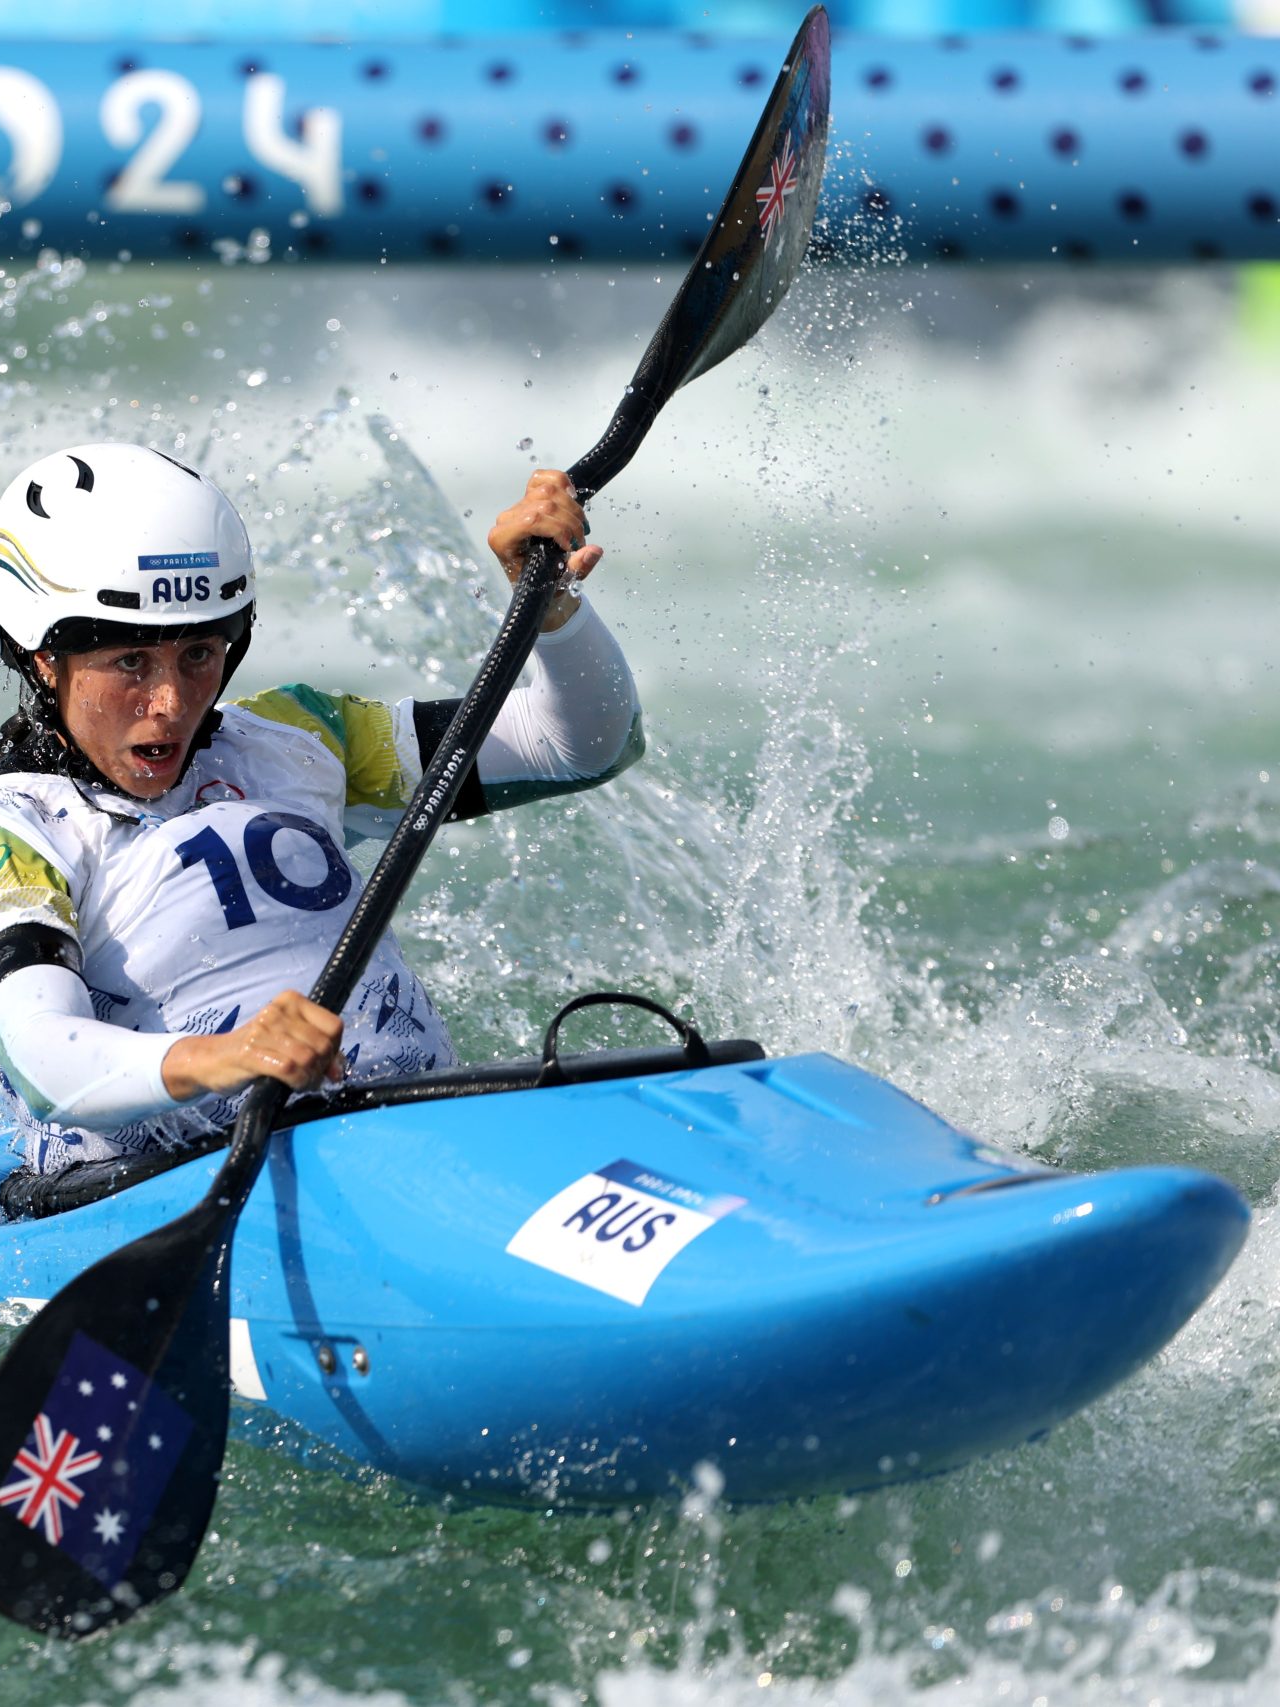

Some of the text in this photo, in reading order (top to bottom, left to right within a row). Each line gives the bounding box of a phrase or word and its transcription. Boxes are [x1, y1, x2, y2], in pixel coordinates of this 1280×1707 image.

[152, 575, 210, 603] AUS
[424, 747, 467, 815] PARIS 2024
[175, 811, 352, 930] 10
[562, 1193, 675, 1252] AUS
